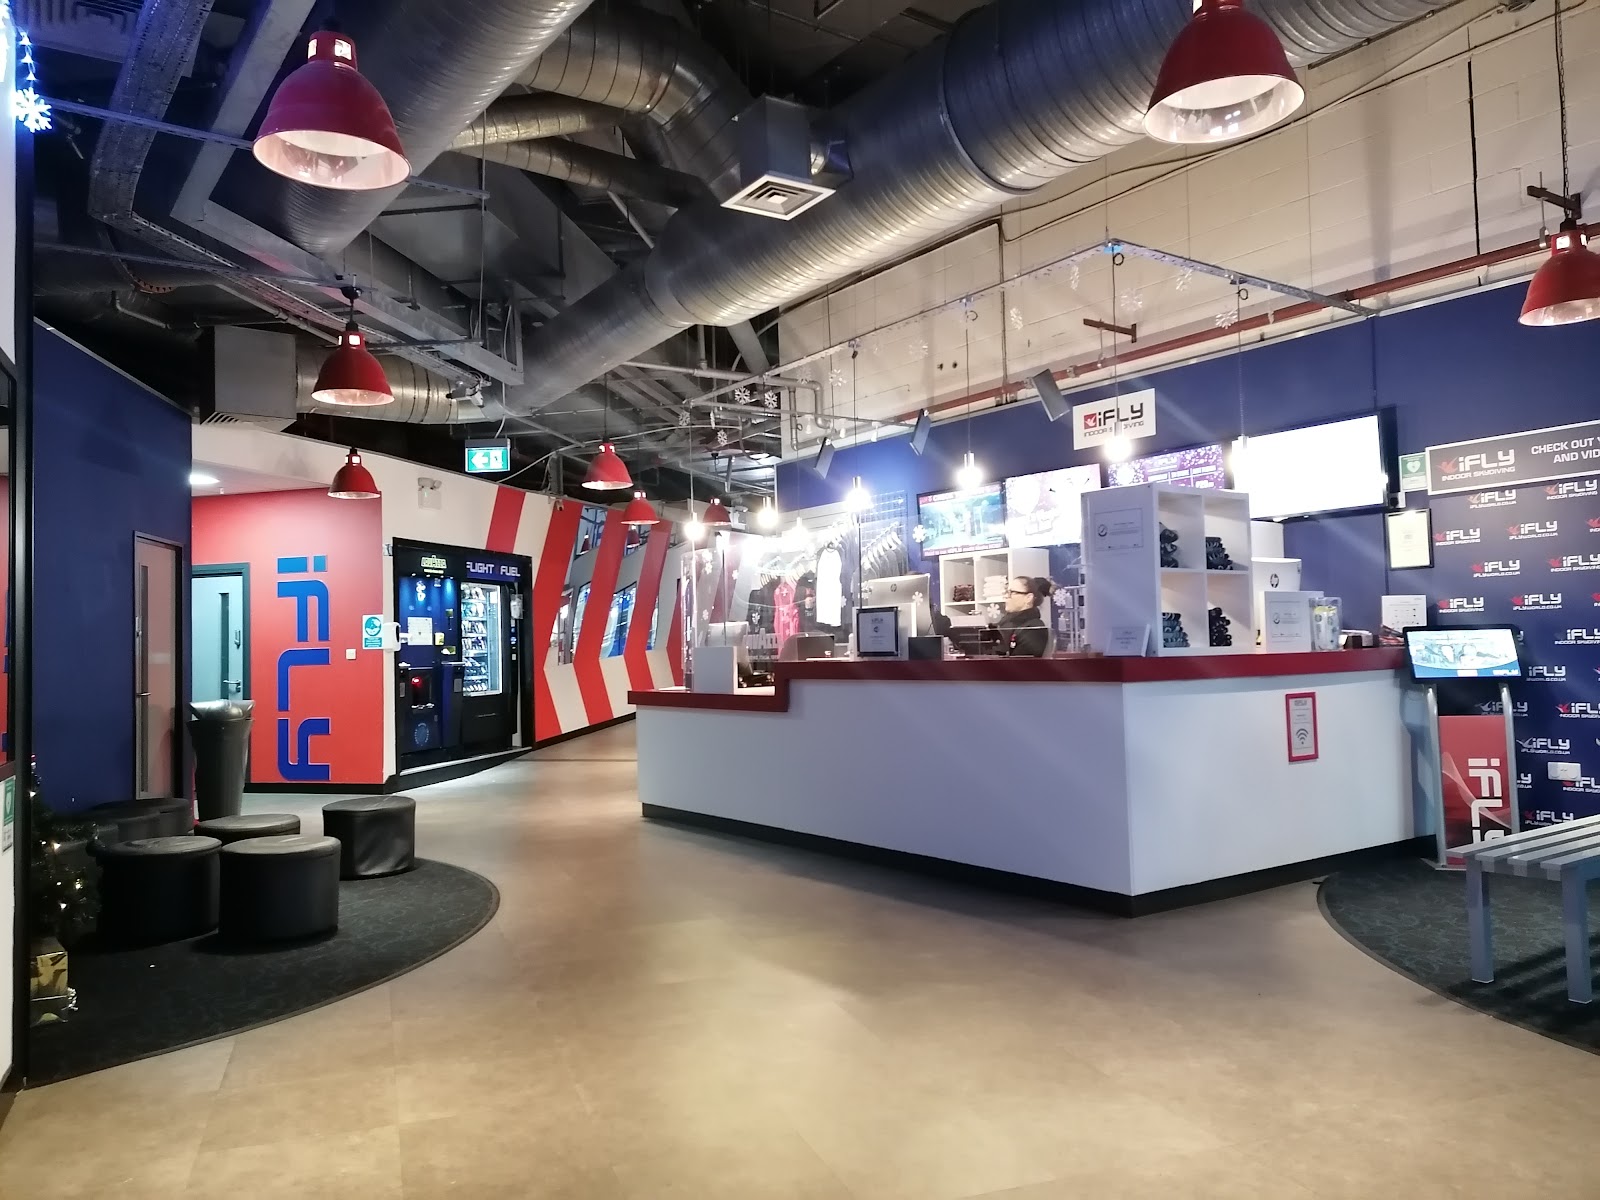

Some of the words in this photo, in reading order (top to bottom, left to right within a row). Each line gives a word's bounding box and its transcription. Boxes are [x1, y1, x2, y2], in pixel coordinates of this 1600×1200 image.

[1098, 402, 1144, 427] iFLY
[1531, 441, 1569, 455] CHECK
[1571, 437, 1594, 449] OUT
[1458, 449, 1515, 472] iFLY
[1553, 452, 1579, 463] AND
[1441, 472, 1472, 481] INDOOR
[1558, 479, 1598, 495] iFLY
[1480, 489, 1516, 504] iFLY
[1446, 527, 1480, 541] iFLY
[1520, 520, 1558, 535] iFLY
[500, 565, 521, 577] FUEL
[1484, 559, 1520, 573] iFLY
[1449, 597, 1484, 609] iFLY
[1524, 592, 1562, 606] iFLY
[277, 555, 330, 781] iFLY
[1528, 665, 1566, 677] iFLY
[1491, 701, 1529, 712] iFY
[1570, 702, 1600, 713] iFL
[1532, 737, 1570, 750] iFLY
